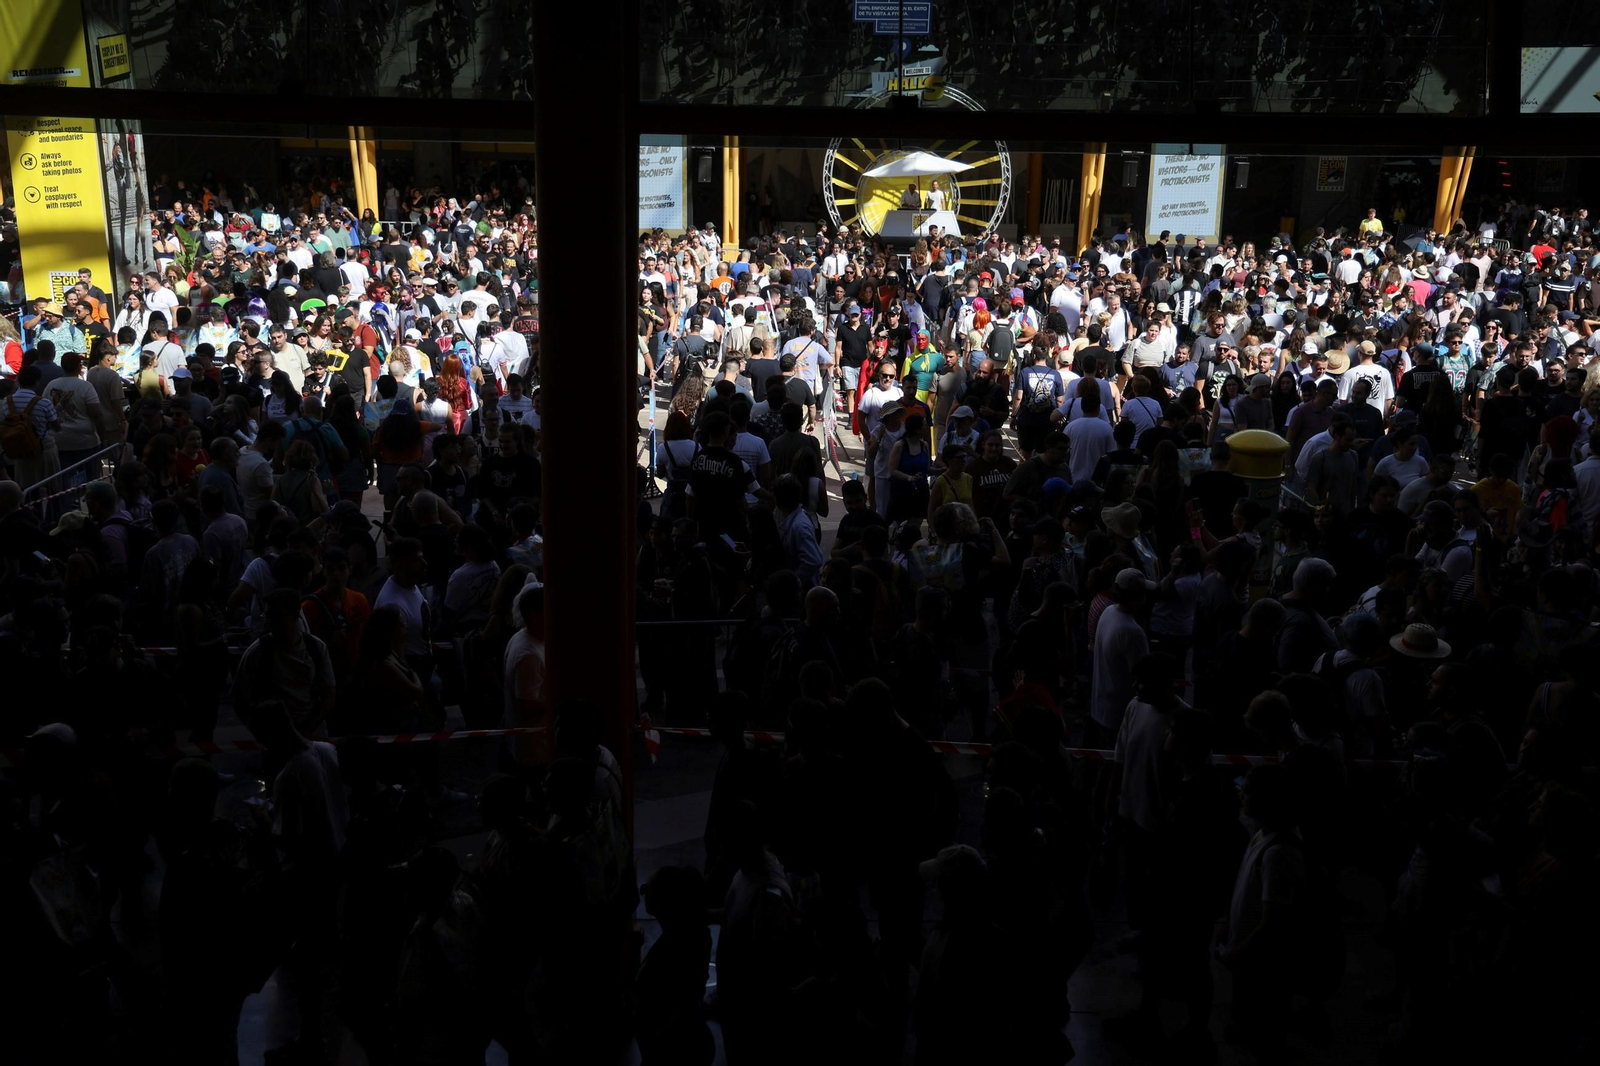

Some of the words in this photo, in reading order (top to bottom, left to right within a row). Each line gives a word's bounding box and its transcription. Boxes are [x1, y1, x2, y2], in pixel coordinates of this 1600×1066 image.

[887, 75, 943, 101] HALLS
[37, 119, 60, 128] Respect
[51, 134, 84, 143] boundaries
[41, 152, 61, 160] Always
[53, 159, 72, 167] before
[62, 167, 82, 176] photos
[1161, 175, 1210, 186] PROTAGONISTS
[45, 192, 77, 201] cosplayers
[60, 200, 83, 209] respect
[1172, 208, 1209, 218] PROTAGONISTAS
[52, 276, 65, 304] COMIC
[698, 454, 734, 479] Angeles
